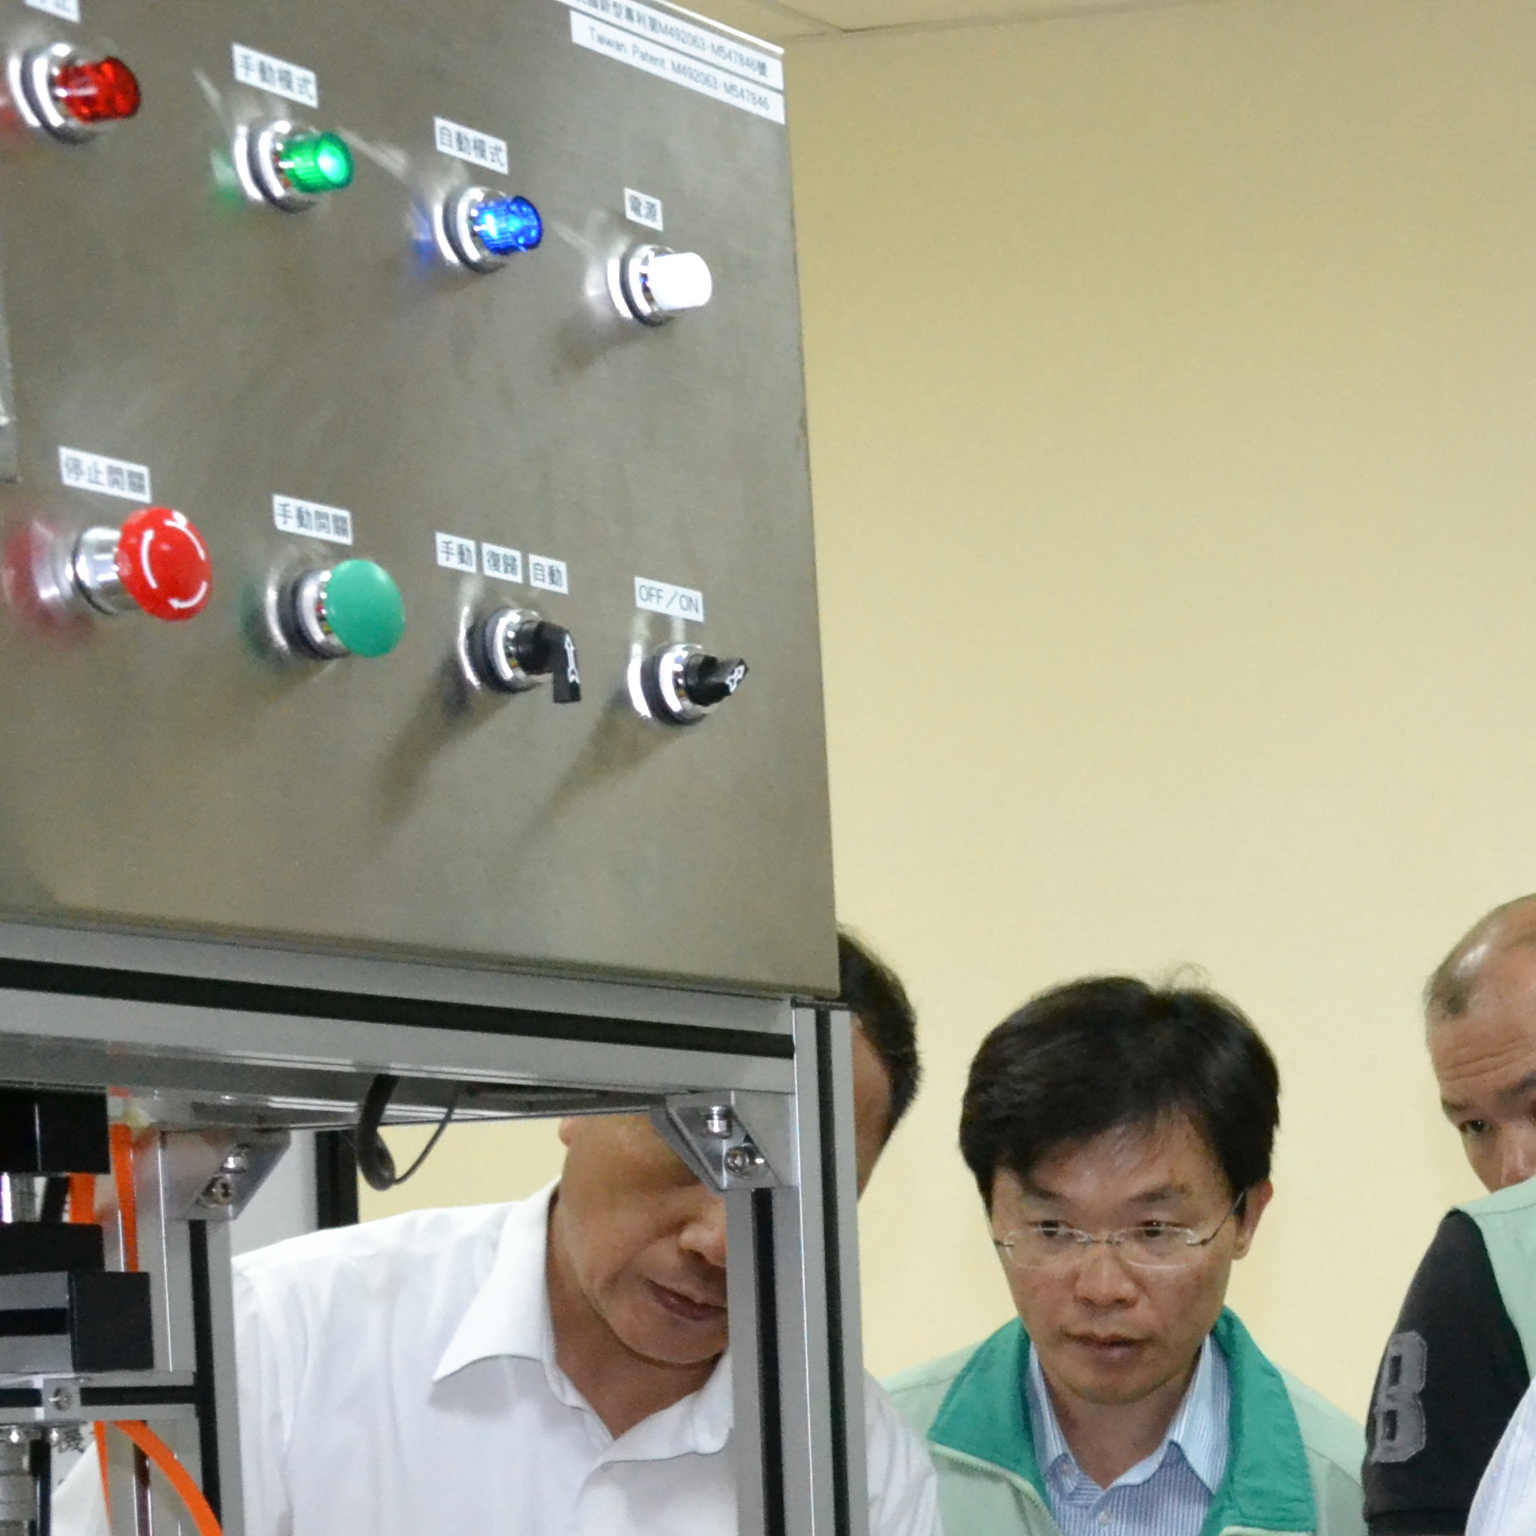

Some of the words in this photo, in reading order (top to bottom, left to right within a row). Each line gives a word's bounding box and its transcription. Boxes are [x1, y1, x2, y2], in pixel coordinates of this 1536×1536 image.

[239, 53, 315, 101] 手動模式
[439, 126, 504, 167] 自動模式
[64, 456, 147, 494] 停止開關
[276, 502, 349, 538] 手動開關
[440, 540, 473, 568] 手動
[532, 562, 564, 588] 自動
